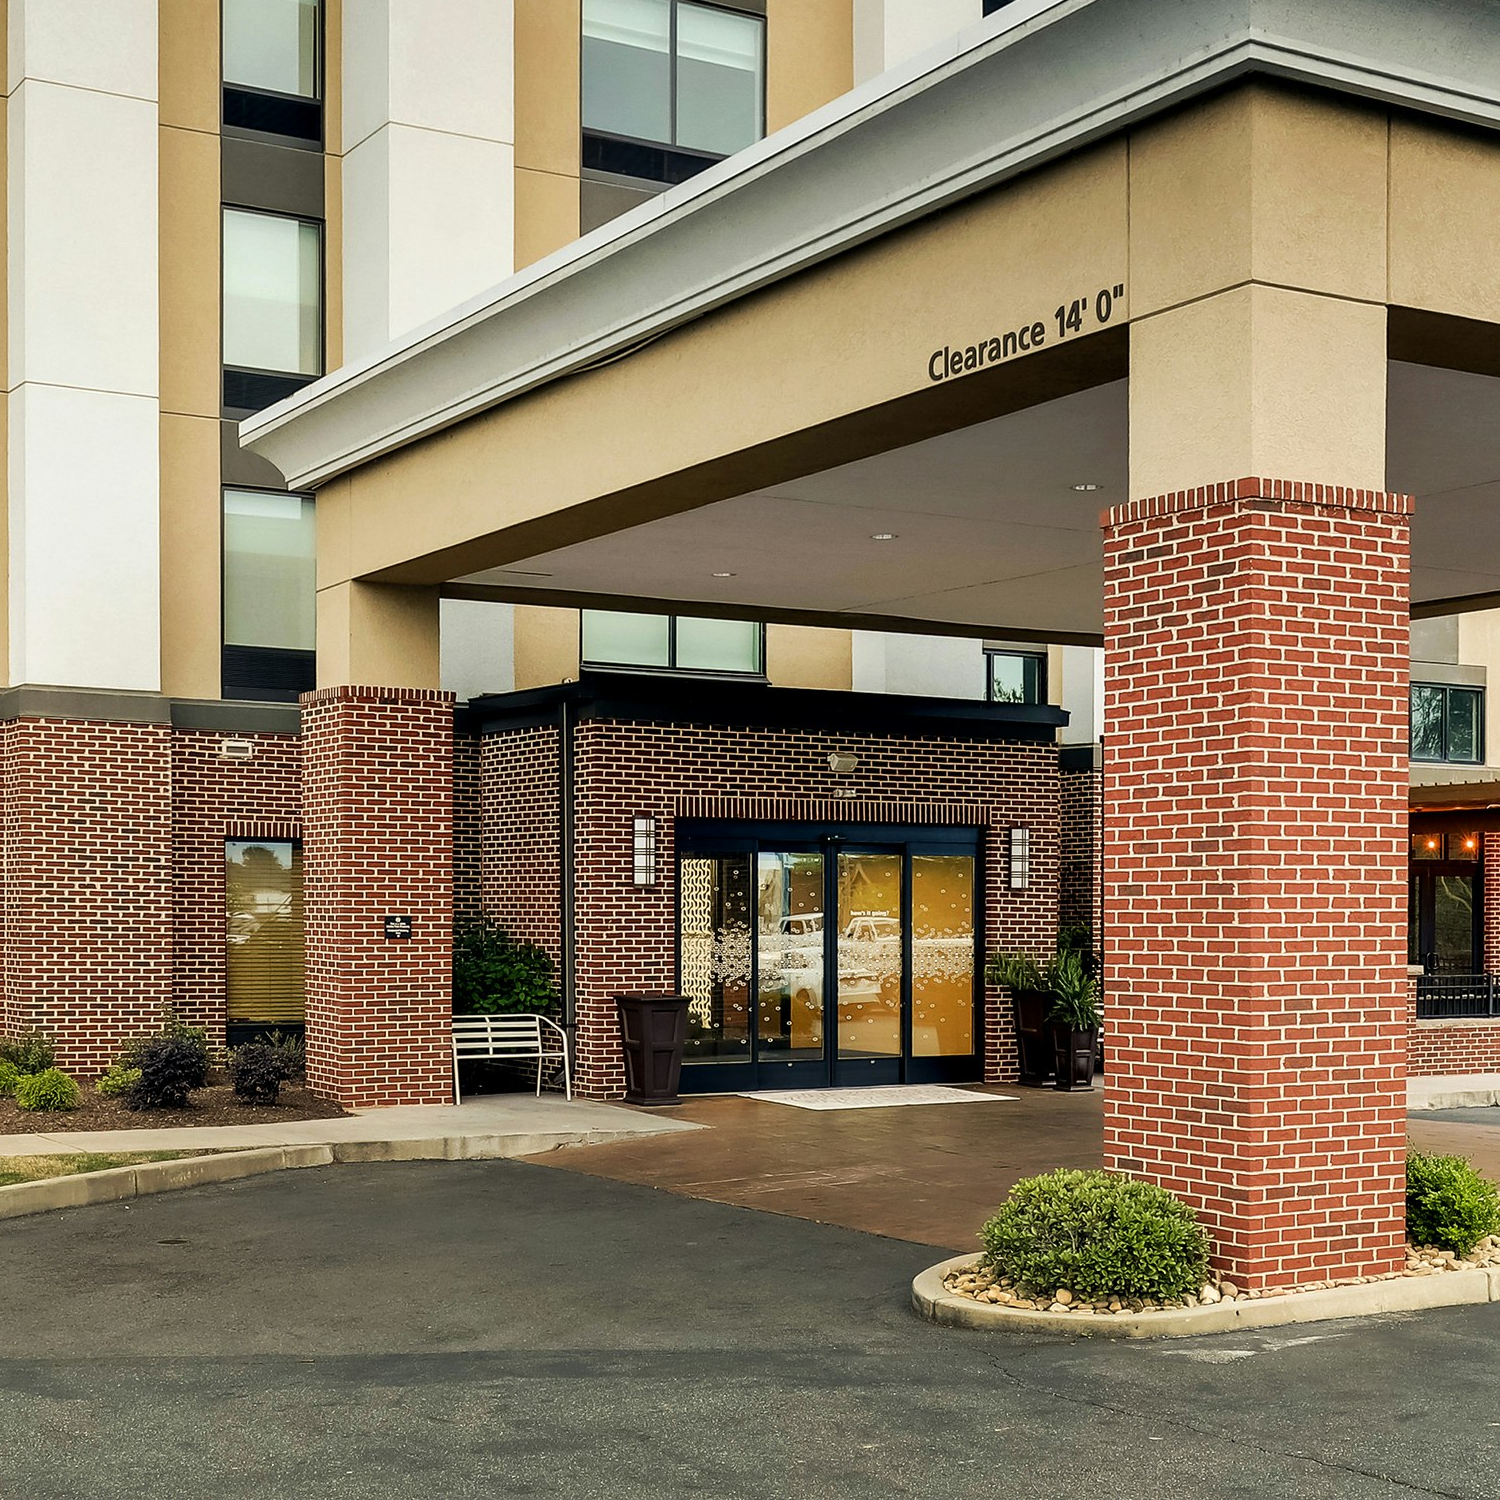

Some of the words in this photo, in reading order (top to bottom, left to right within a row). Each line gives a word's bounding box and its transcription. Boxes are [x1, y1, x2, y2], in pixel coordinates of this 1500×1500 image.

[928, 321, 1045, 382] Clearance
[1054, 297, 1087, 338] 14'
[1095, 283, 1124, 323] 0"
